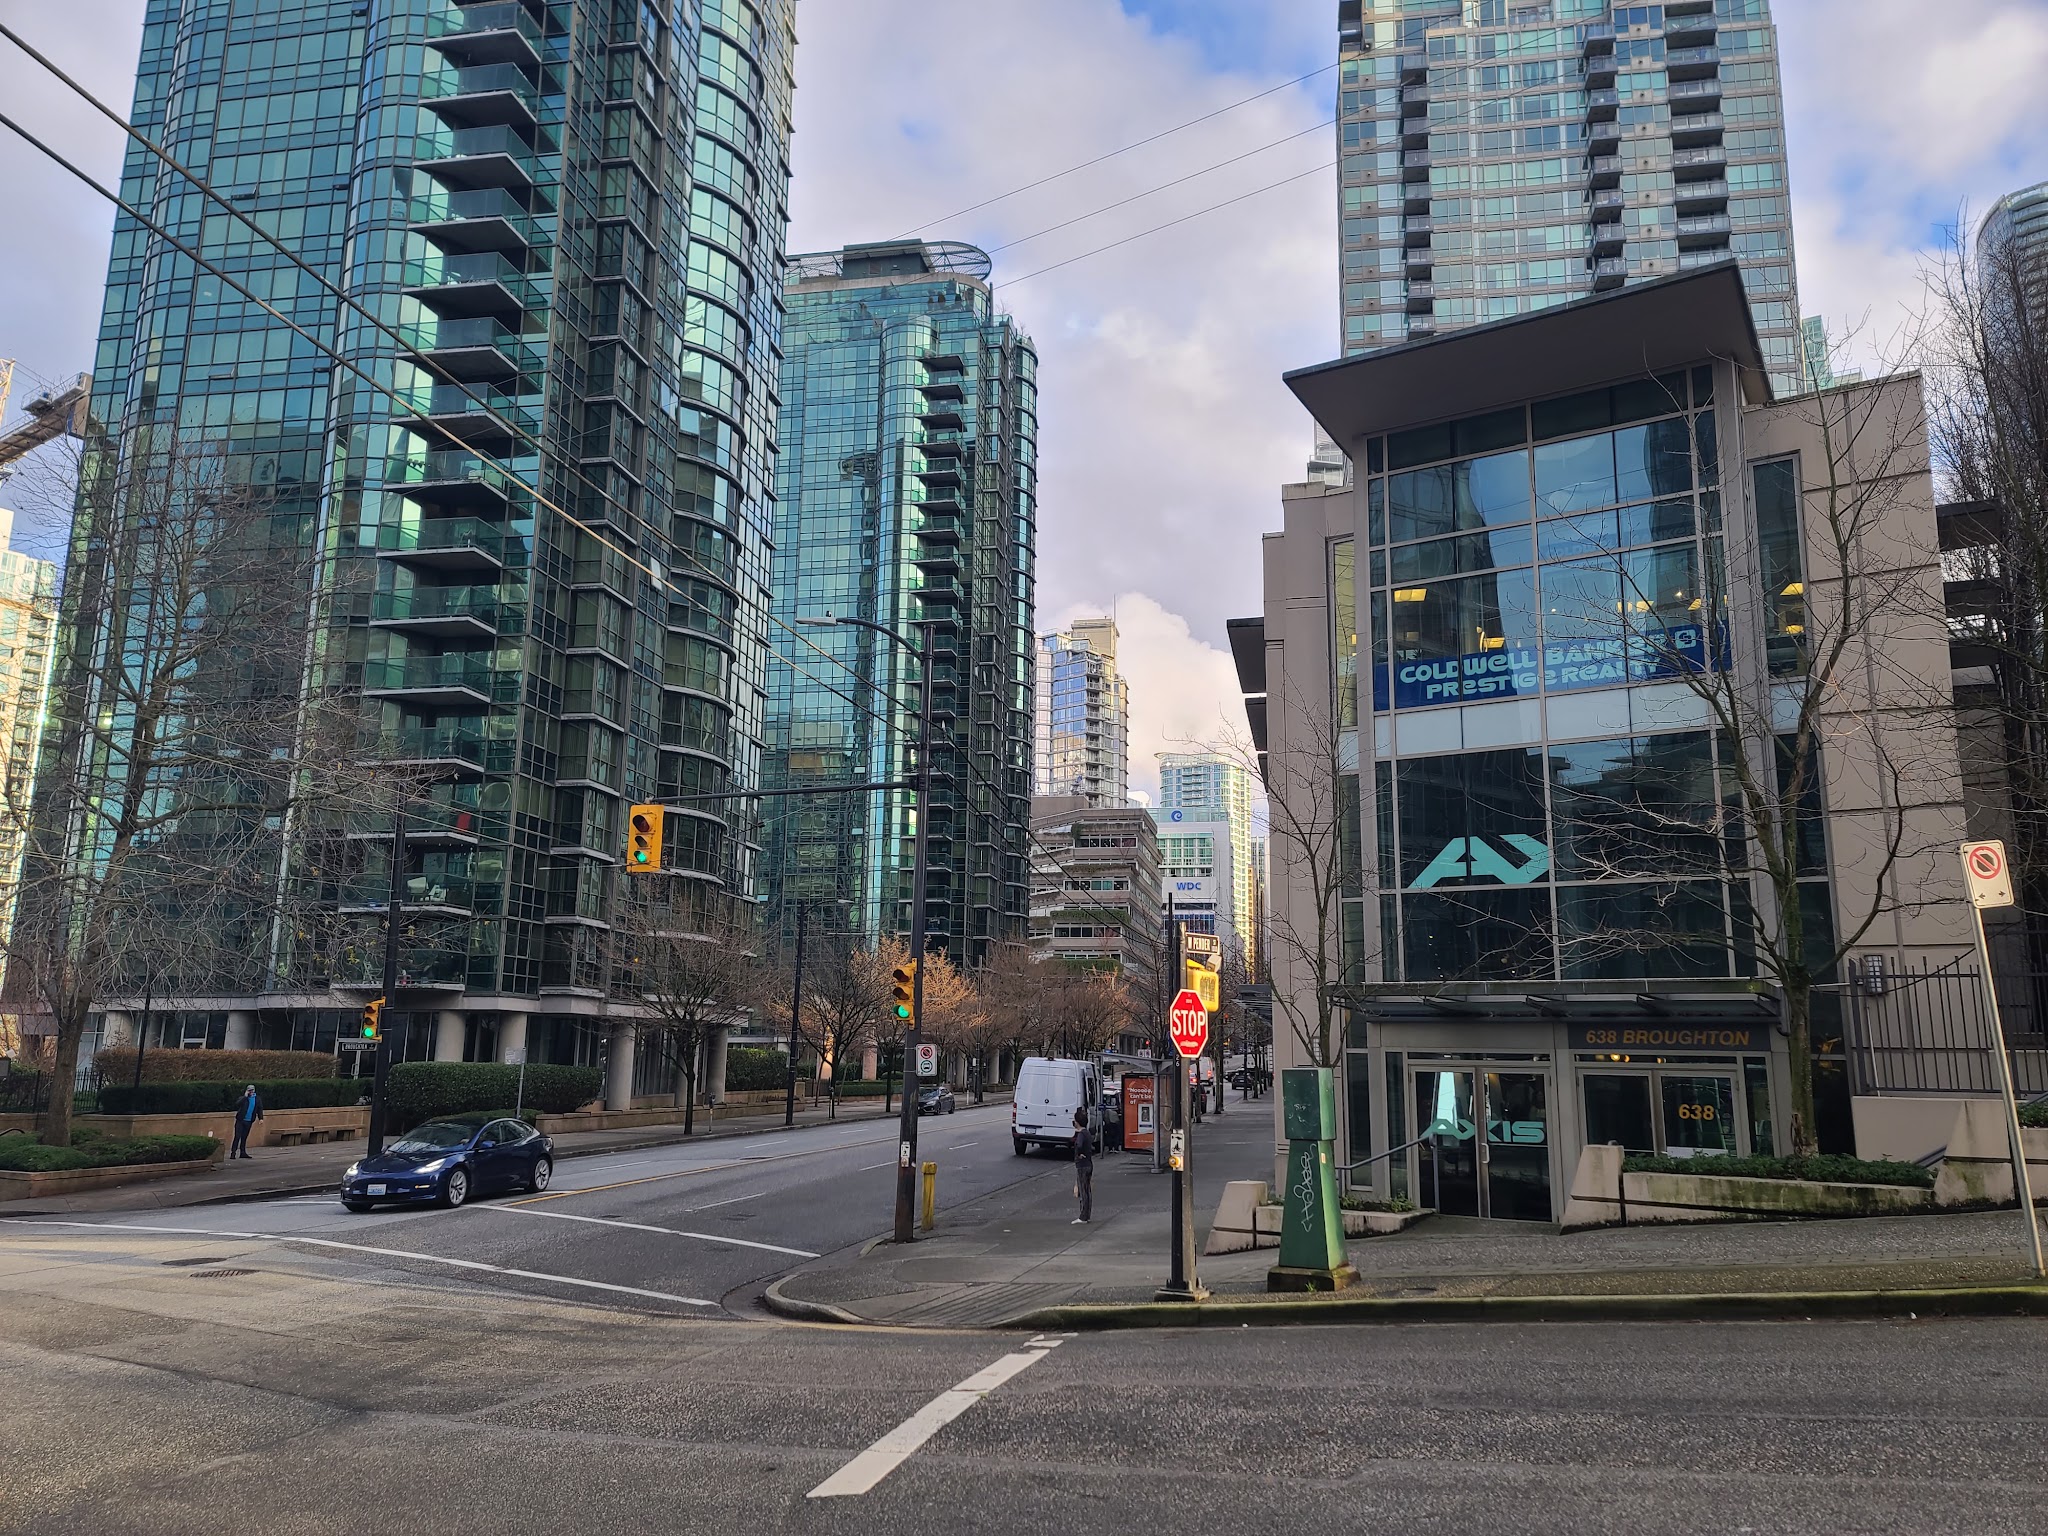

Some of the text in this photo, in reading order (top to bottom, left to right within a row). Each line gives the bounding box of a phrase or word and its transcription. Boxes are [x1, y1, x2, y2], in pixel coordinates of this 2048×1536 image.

[1400, 651, 1537, 684] COLDWELL
[1426, 669, 1557, 699] PRESTIGE
[1176, 882, 1202, 891] WDC
[1172, 1009, 1206, 1037] STOP
[1586, 1029, 1749, 1046] 638 BROUGHTON
[1679, 1103, 1715, 1120] 638
[1420, 1119, 1545, 1143] AXIS
